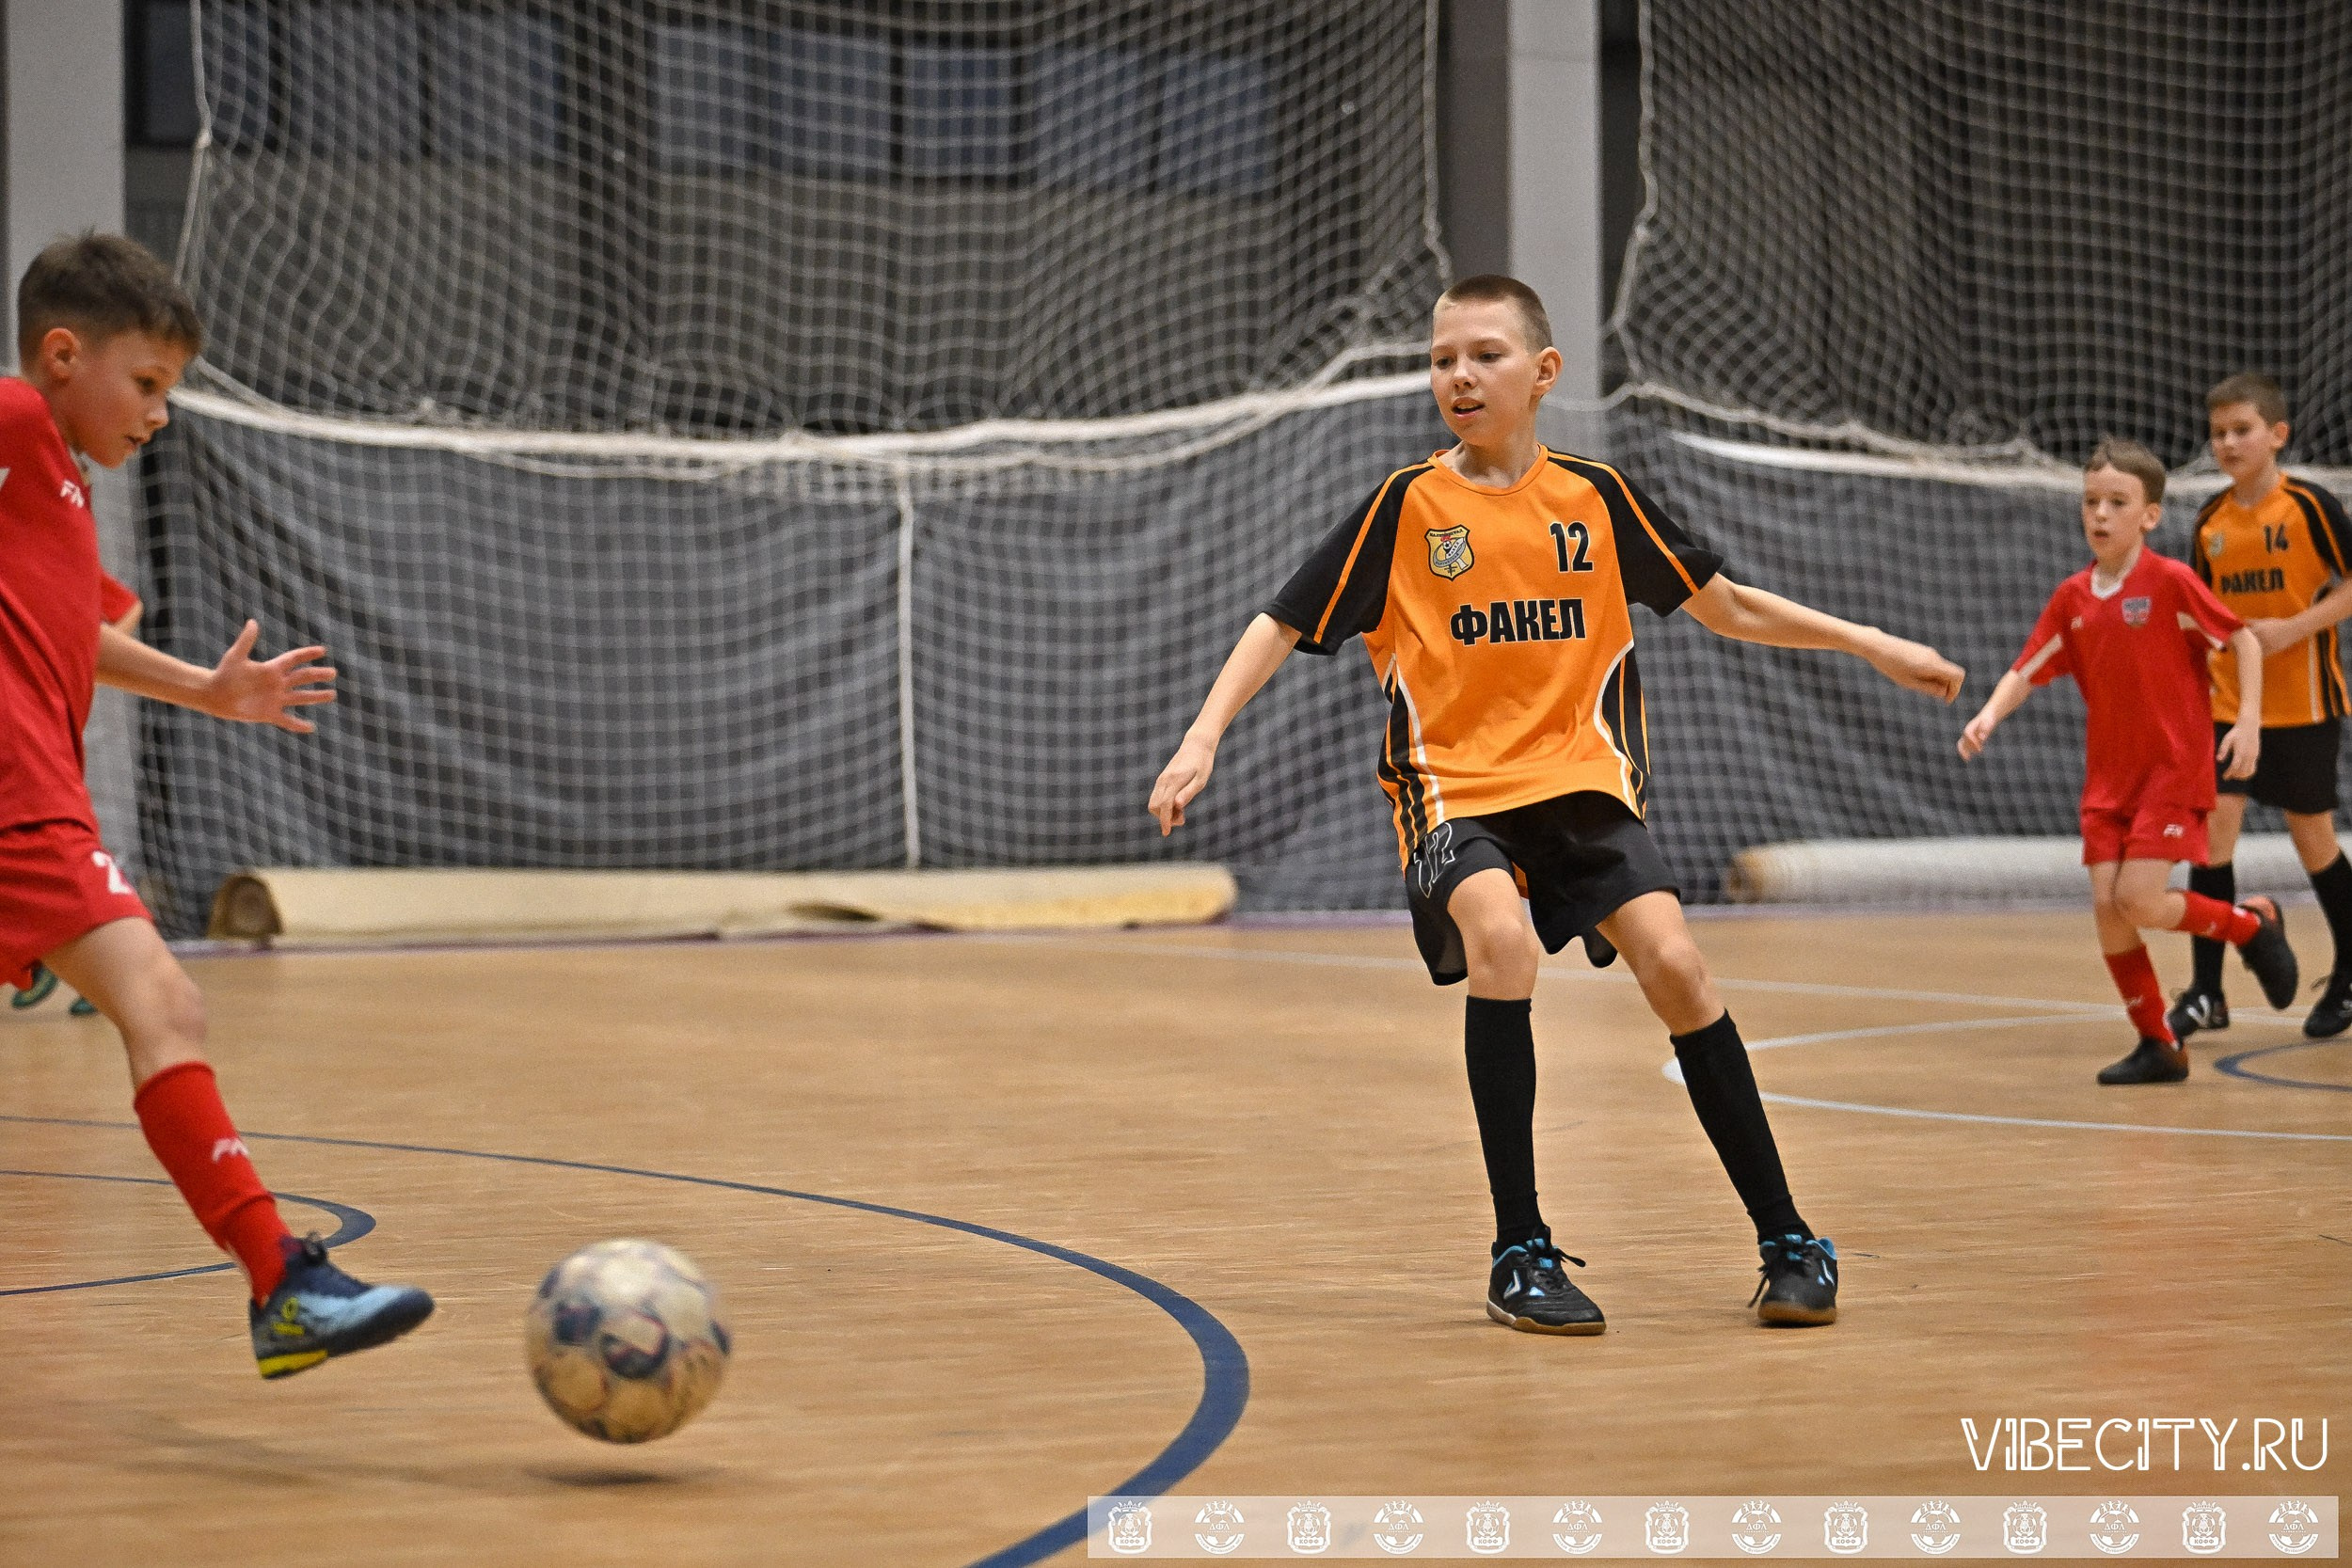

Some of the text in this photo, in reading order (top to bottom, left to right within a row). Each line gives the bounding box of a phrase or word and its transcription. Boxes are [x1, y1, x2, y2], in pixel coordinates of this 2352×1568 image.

[1549, 521, 1594, 573] 12
[2264, 523, 2288, 554] 14
[1450, 597, 1587, 647] ФАКЕЛ
[1413, 821, 1455, 899] 12
